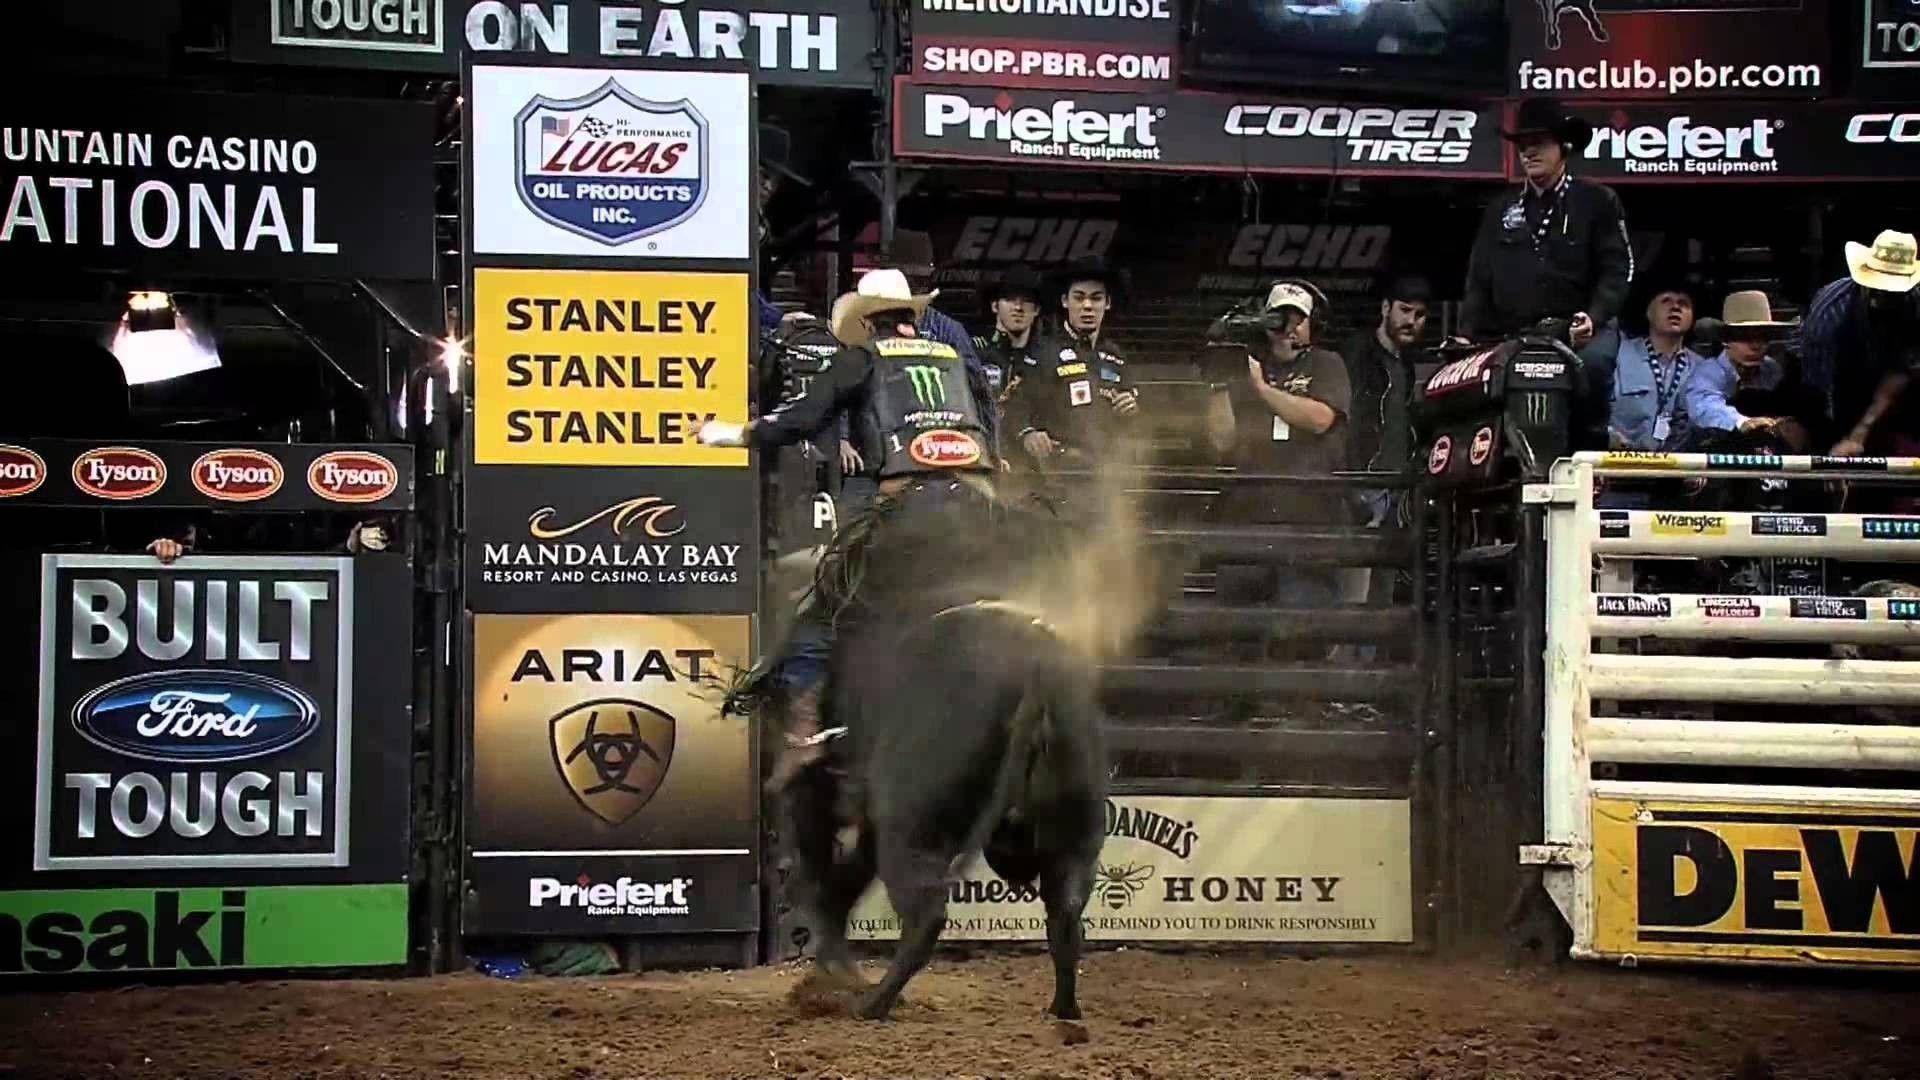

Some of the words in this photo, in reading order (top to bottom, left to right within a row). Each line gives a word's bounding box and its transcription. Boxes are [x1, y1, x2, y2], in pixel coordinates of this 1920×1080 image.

[293, 0, 428, 35] TOUGH
[465, 2, 569, 53] ON
[600, 6, 838, 71] EARTH
[923, 47, 1170, 79] SHOP.PBR.COM
[1518, 60, 1821, 93] fanclub.pbr.com
[616, 129, 692, 138] PERFORMANCE
[924, 93, 1157, 147] Priefert
[1224, 105, 1478, 140] COOPER
[1583, 113, 1775, 159] riefert
[3, 128, 153, 167] UNTAIN
[167, 135, 318, 174] CASINO
[543, 140, 688, 174] LUCAS
[1010, 140, 1064, 157] Ranch
[1068, 143, 1161, 161] Equipment
[1346, 139, 1472, 163] TIRES
[1625, 158, 1679, 173] Ranch
[1684, 159, 1778, 175] Equipment
[532, 183, 570, 199] OIL
[576, 184, 692, 201] PRODUCTS
[0, 175, 339, 254] ATIONAL
[592, 207, 636, 224] INC.
[953, 216, 1120, 263] ECHO
[1228, 224, 1392, 269] ECHO
[506, 297, 716, 333] STANLEY
[506, 354, 716, 389] STANLEY
[84, 458, 157, 491] Tyson
[204, 460, 275, 489] Tyson
[319, 462, 389, 491] Tyson
[1655, 513, 1722, 533] Wrangler
[484, 543, 672, 567] MANDALAY
[683, 544, 741, 567] BAY
[484, 571, 544, 582] RESORT
[551, 571, 585, 582] AND
[658, 571, 686, 582] LAS
[690, 571, 739, 582] VEGAS
[1599, 598, 1625, 612] JACK
[1700, 598, 1750, 608] LINCOLN
[1710, 607, 1756, 617] WELDERS
[72, 579, 329, 660] BUILT
[511, 649, 715, 682] ARIAT
[136, 690, 258, 738] Ford
[65, 771, 324, 838] TOUGH
[1104, 799, 1198, 859] DANIEL'S
[529, 875, 687, 907] Priefert
[1162, 877, 1341, 902] HONEY
[588, 906, 624, 915] Ranch
[627, 906, 689, 916] Equipment
[966, 919, 985, 931] AT
[987, 919, 1025, 934] JACK
[1100, 918, 1160, 930] REMIND
[1164, 918, 1196, 930] YOU
[1199, 918, 1221, 930] TO
[1225, 918, 1275, 930] DRINK
[1279, 918, 1378, 931] RESPONSIBLY
